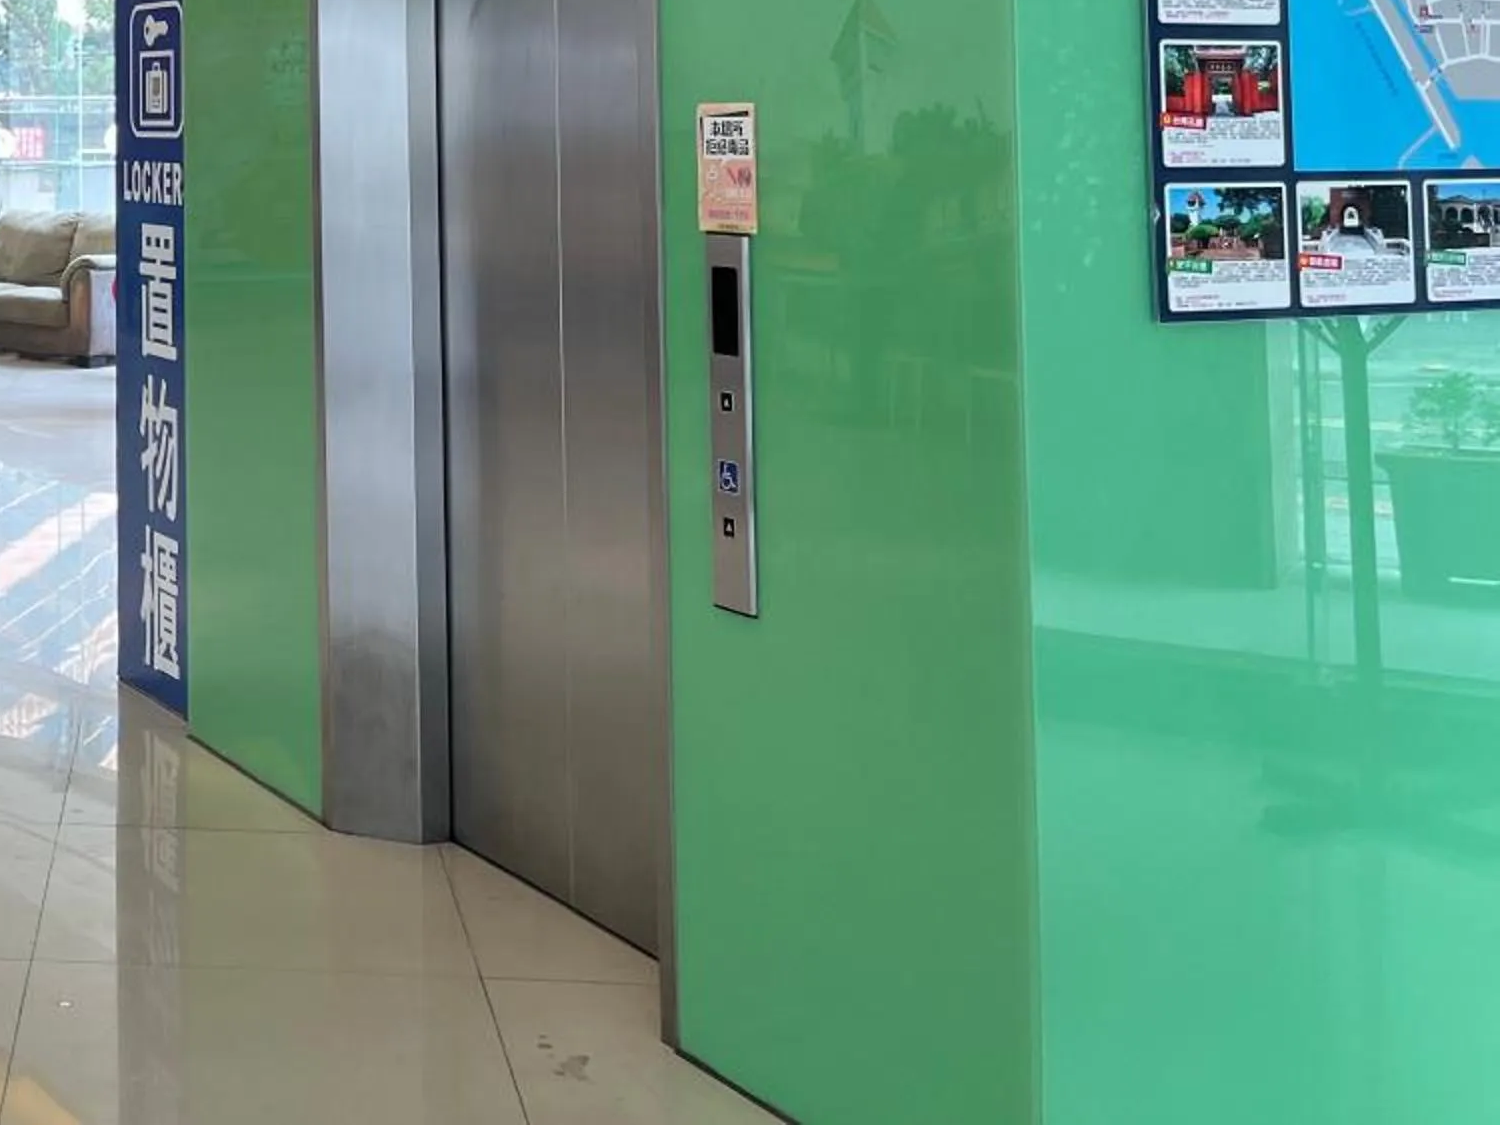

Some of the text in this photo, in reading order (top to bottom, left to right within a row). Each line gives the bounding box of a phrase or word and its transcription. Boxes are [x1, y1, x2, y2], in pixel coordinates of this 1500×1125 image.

[123, 160, 183, 206] LOCKER
[140, 222, 180, 681] 置物櫃
